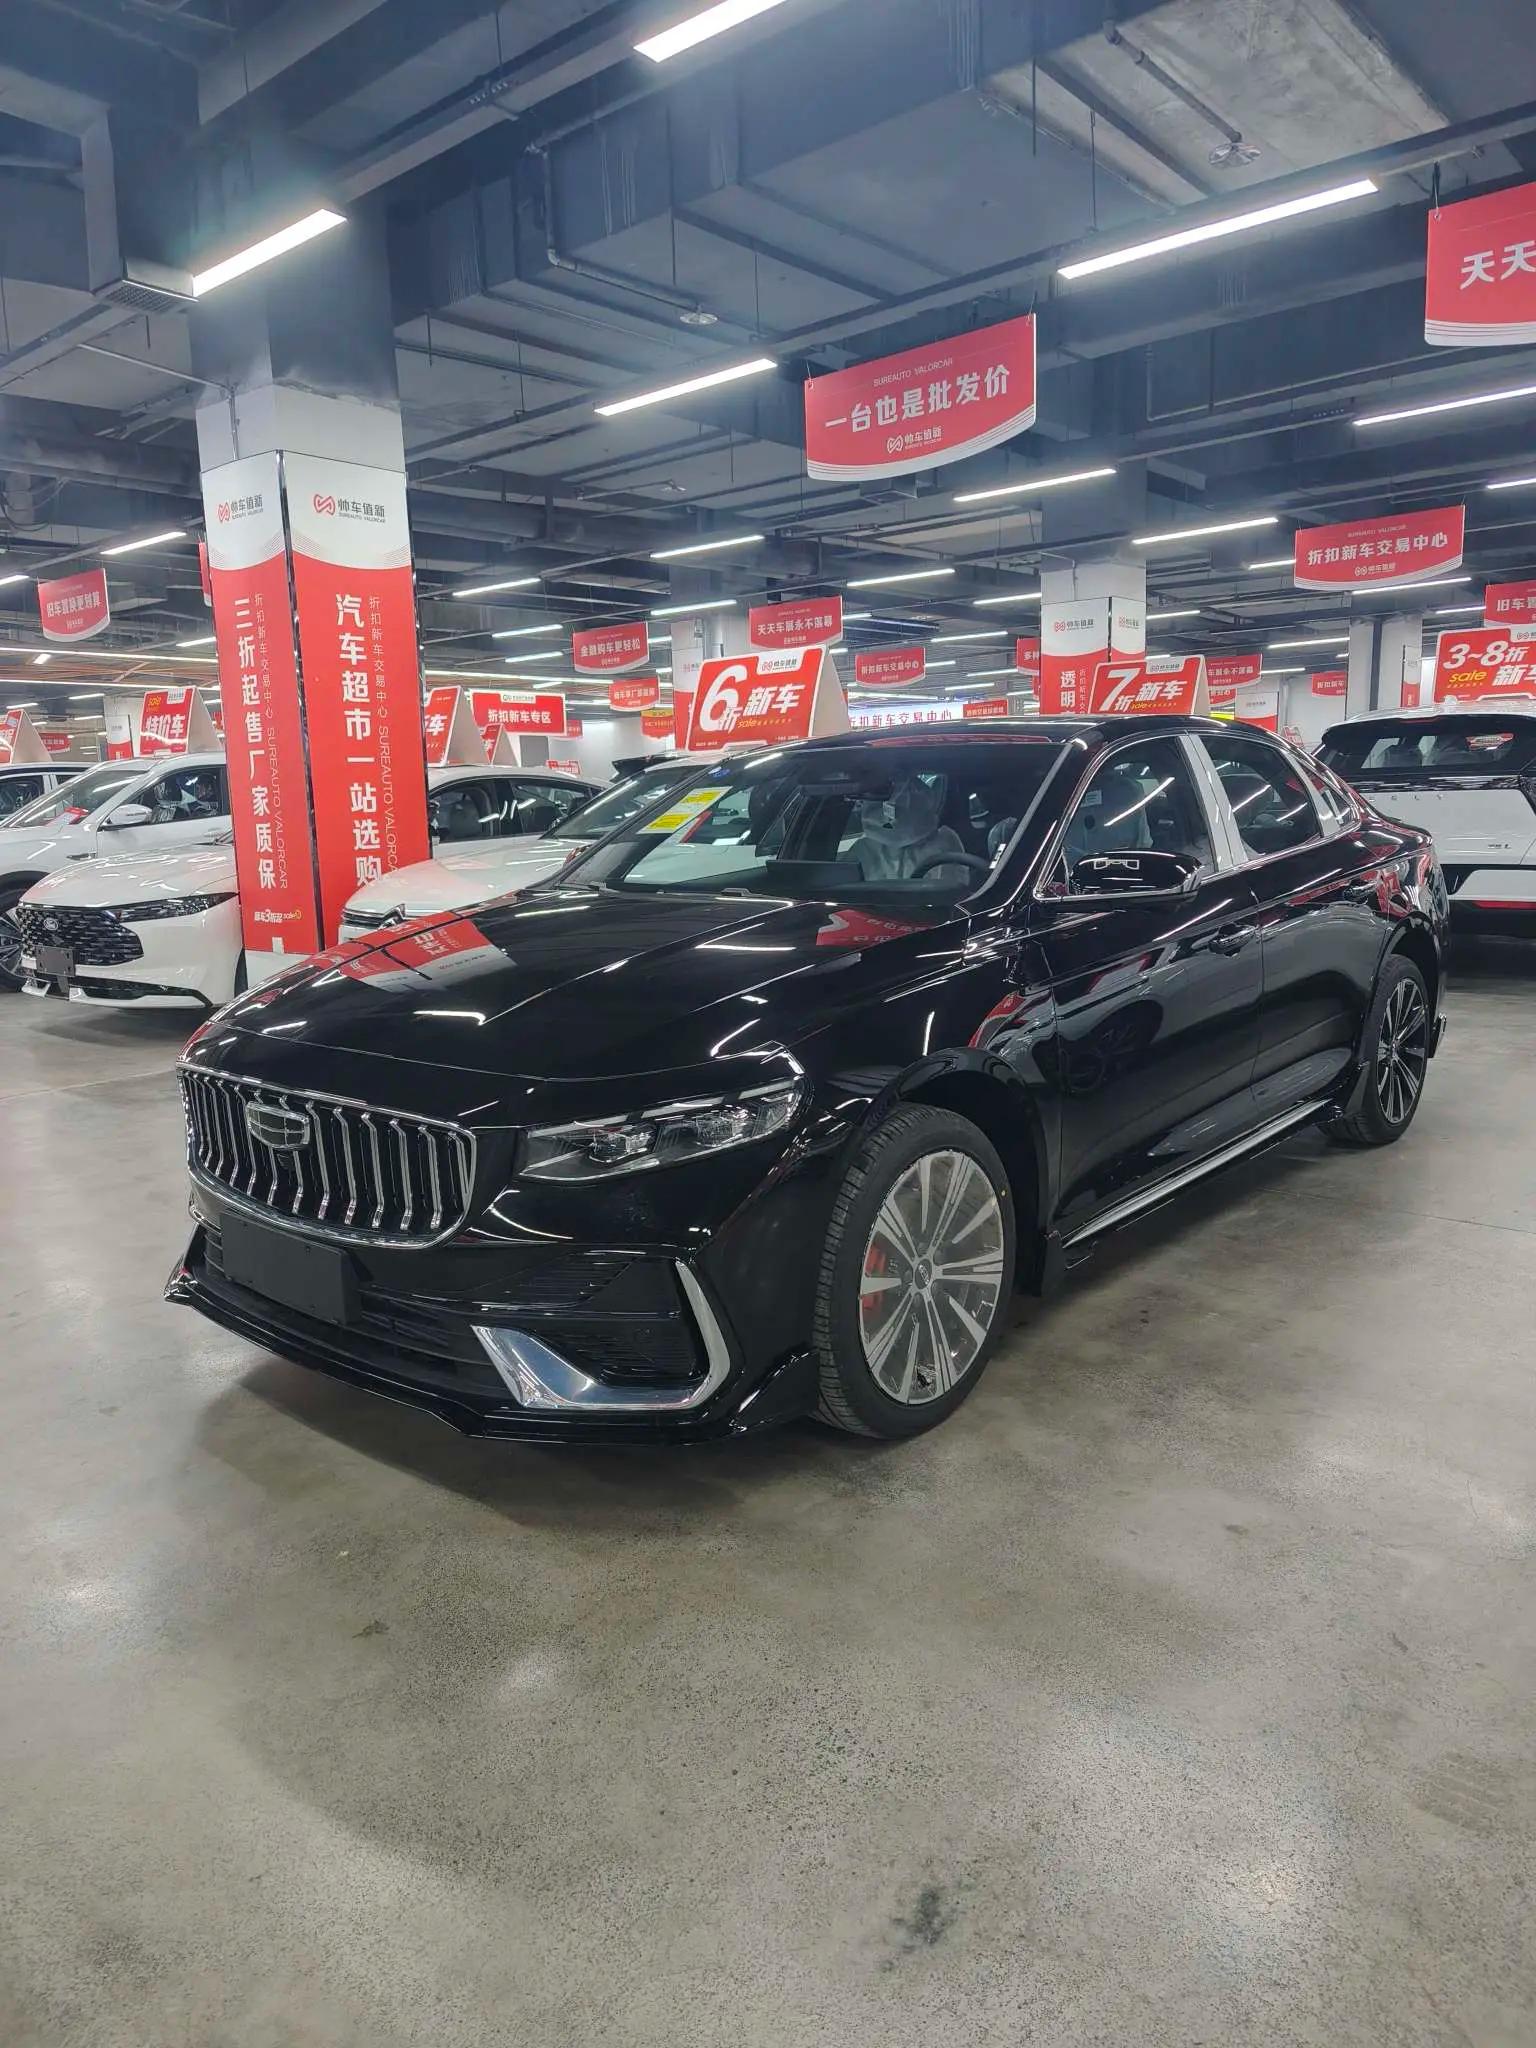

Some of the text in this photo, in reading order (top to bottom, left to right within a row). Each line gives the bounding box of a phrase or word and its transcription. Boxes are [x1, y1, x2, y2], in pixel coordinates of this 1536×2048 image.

[1460, 239, 1536, 290] 天天
[873, 357, 953, 387] SUREAUTO VALORCAR
[825, 364, 1010, 433] 一台也是批发价
[1307, 531, 1448, 566] 折扣新车交易中心
[254, 593, 274, 719] 折扣新车交易中心
[369, 596, 388, 719] 折扣新车交易中心
[1449, 670, 1488, 683] sale
[700, 664, 747, 735] 6折
[743, 683, 806, 717] 新车
[1060, 670, 1077, 714] 透明
[1099, 667, 1141, 713] 7折
[1135, 679, 1188, 701] 新车
[145, 713, 185, 738] 特价车
[335, 593, 382, 887] 汽车超市一站选购
[488, 708, 552, 725] 折扣新车专区
[234, 598, 277, 889] 三折起售厂家质保
[378, 726, 393, 808] SUREAUTO
[266, 727, 288, 889] SUREAUTO VALORCAR
